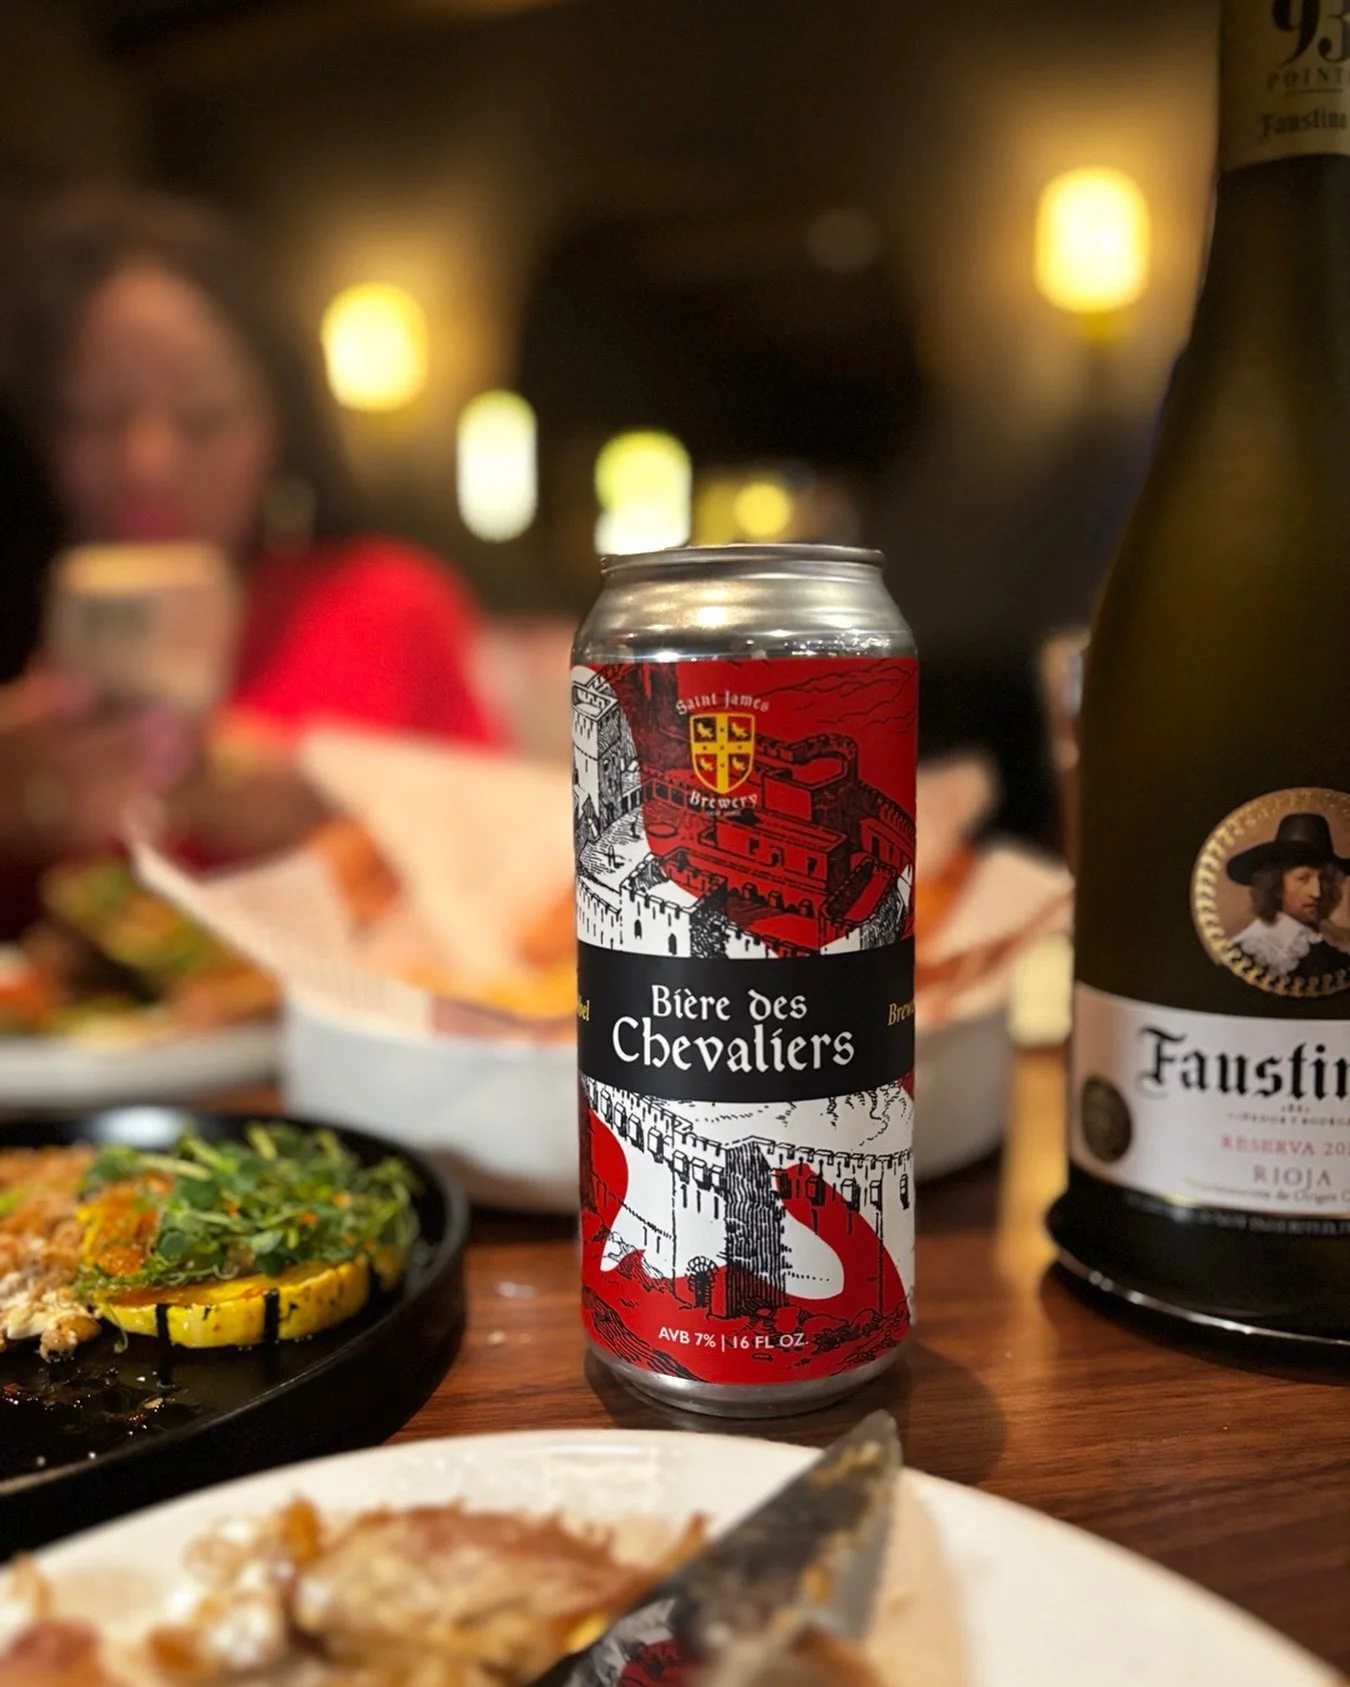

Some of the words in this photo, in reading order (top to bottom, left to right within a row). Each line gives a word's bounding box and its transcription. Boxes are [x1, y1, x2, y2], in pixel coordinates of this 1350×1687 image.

[676, 692, 717, 715] Saint
[725, 690, 771, 712] James
[690, 790, 758, 809] Brewery
[651, 983, 732, 1021] Bière
[748, 989, 807, 1021] des
[612, 1016, 855, 1073] Chevaliers
[1220, 1132, 1315, 1157] RESERVA
[1323, 1140, 1350, 1157] 20
[1252, 1163, 1332, 1190] RIOJA
[658, 1326, 690, 1345] AVB
[694, 1332, 717, 1348] 7%
[733, 1335, 749, 1349] 16
[755, 1335, 774, 1349] FL
